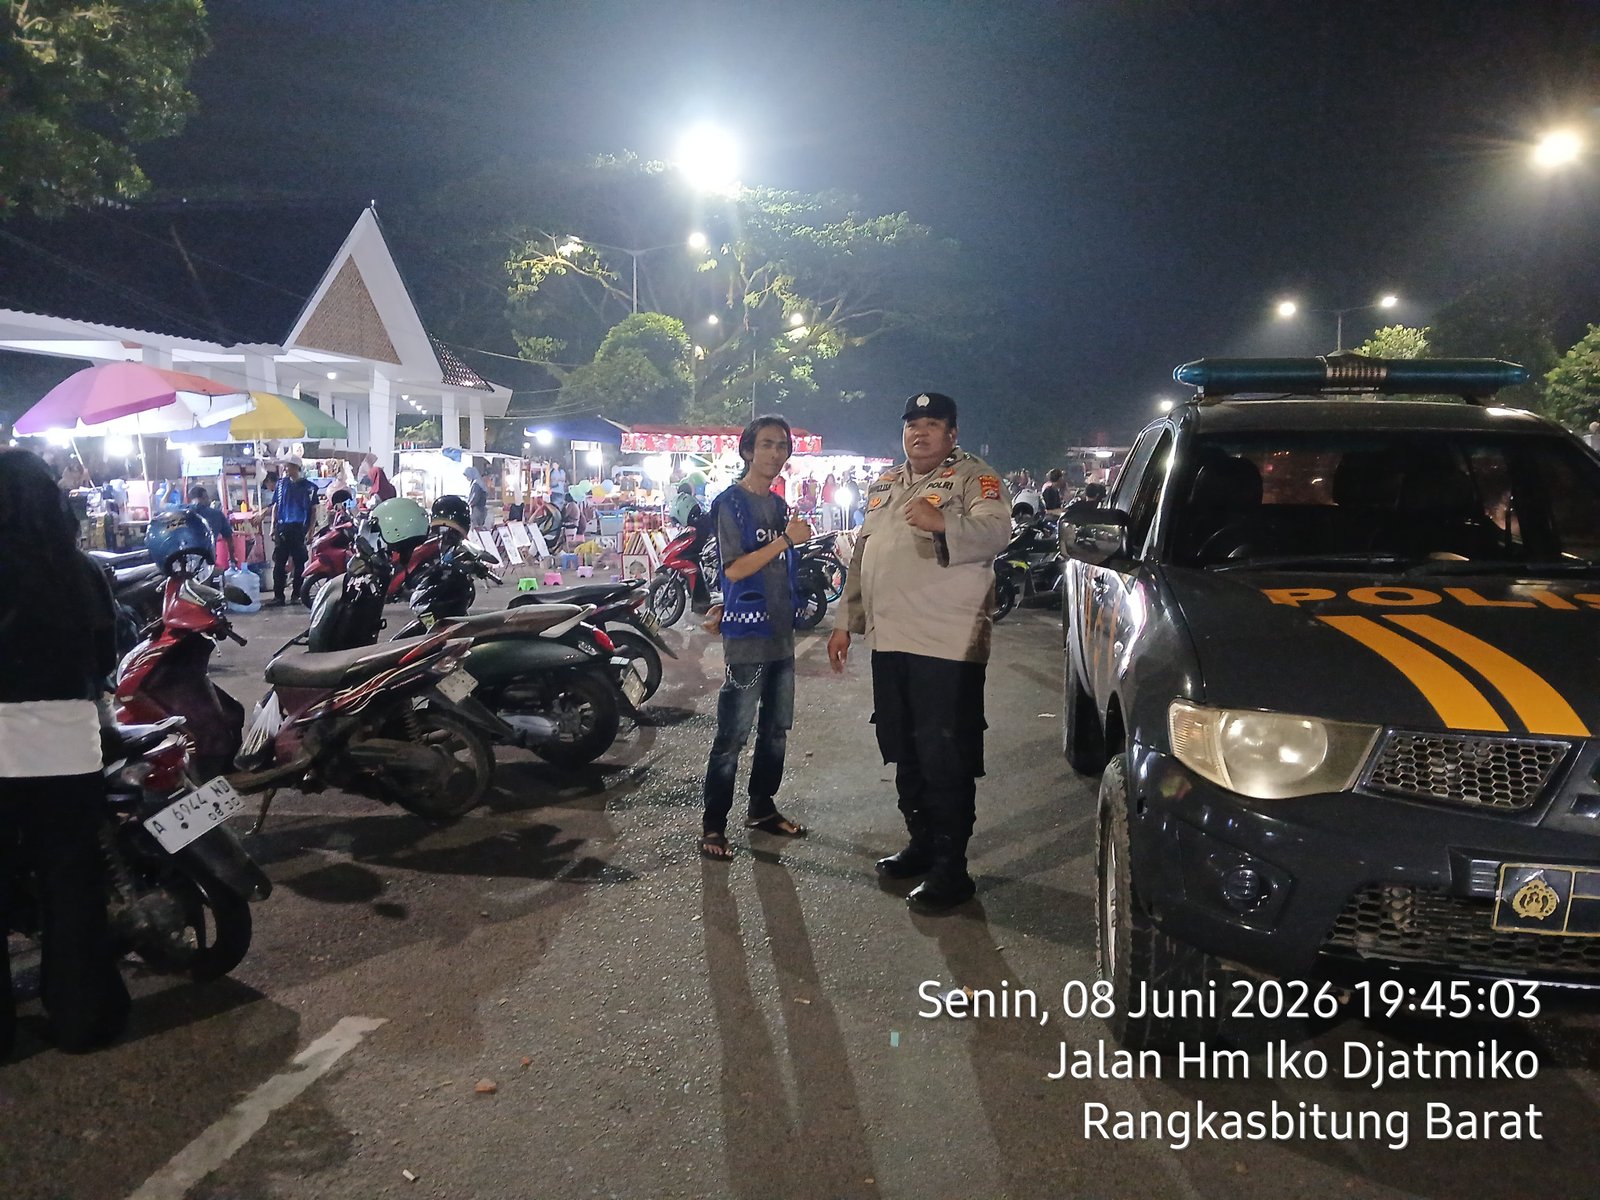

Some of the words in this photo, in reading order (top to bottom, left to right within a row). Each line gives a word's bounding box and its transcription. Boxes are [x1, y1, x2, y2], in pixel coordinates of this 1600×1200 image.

[926, 481, 954, 491] POLRI
[1261, 586, 1600, 611] POLI
[152, 820, 167, 835] A
